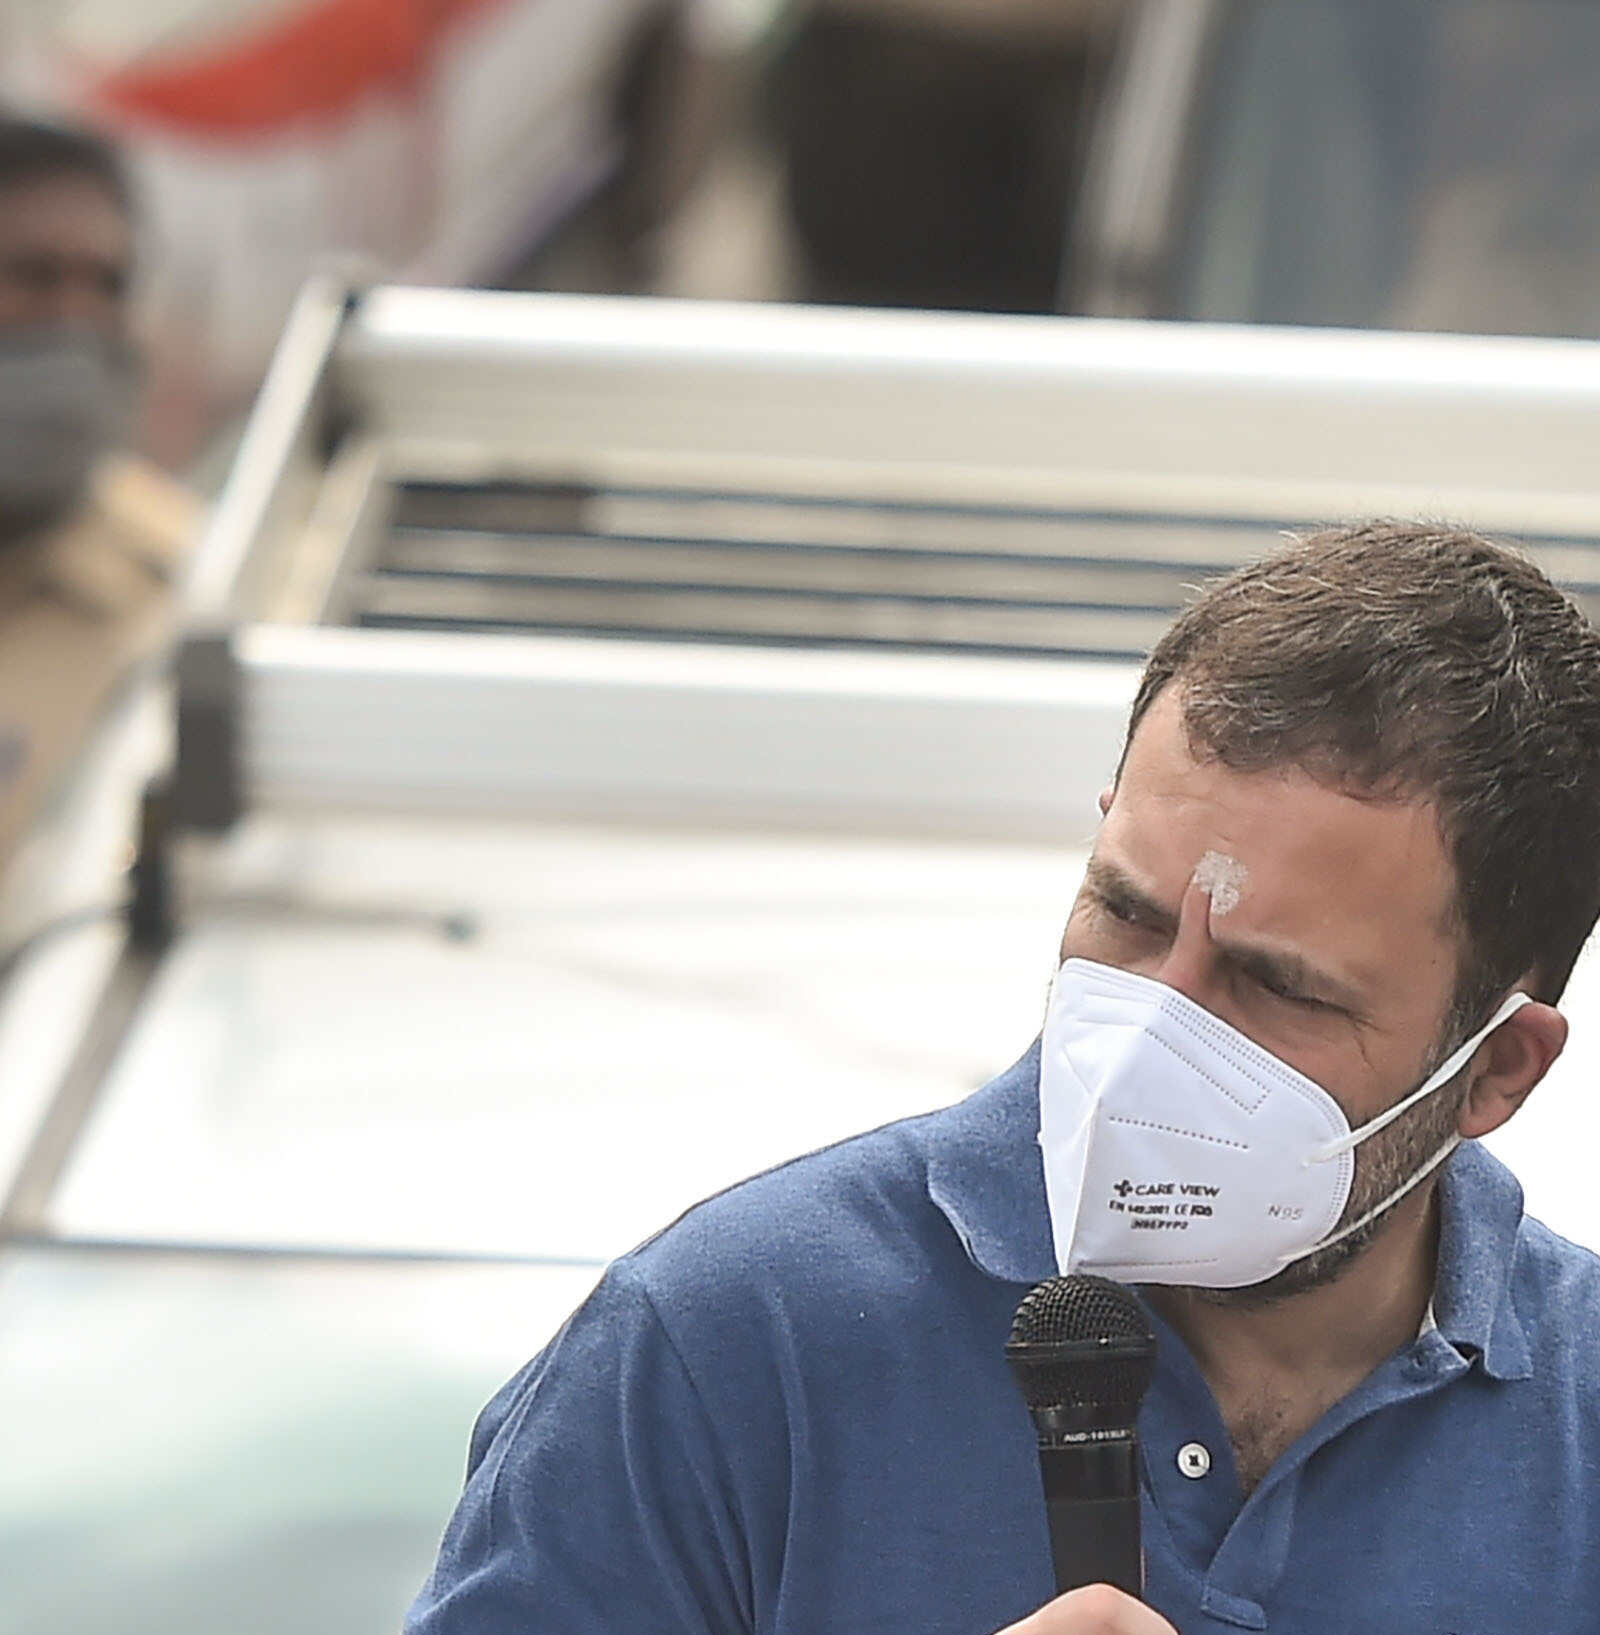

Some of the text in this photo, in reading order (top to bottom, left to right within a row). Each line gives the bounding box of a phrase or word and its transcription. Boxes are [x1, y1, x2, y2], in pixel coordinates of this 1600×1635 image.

[1135, 1184, 1220, 1197] CARE VIEW
[1268, 1205, 1303, 1220] N95
